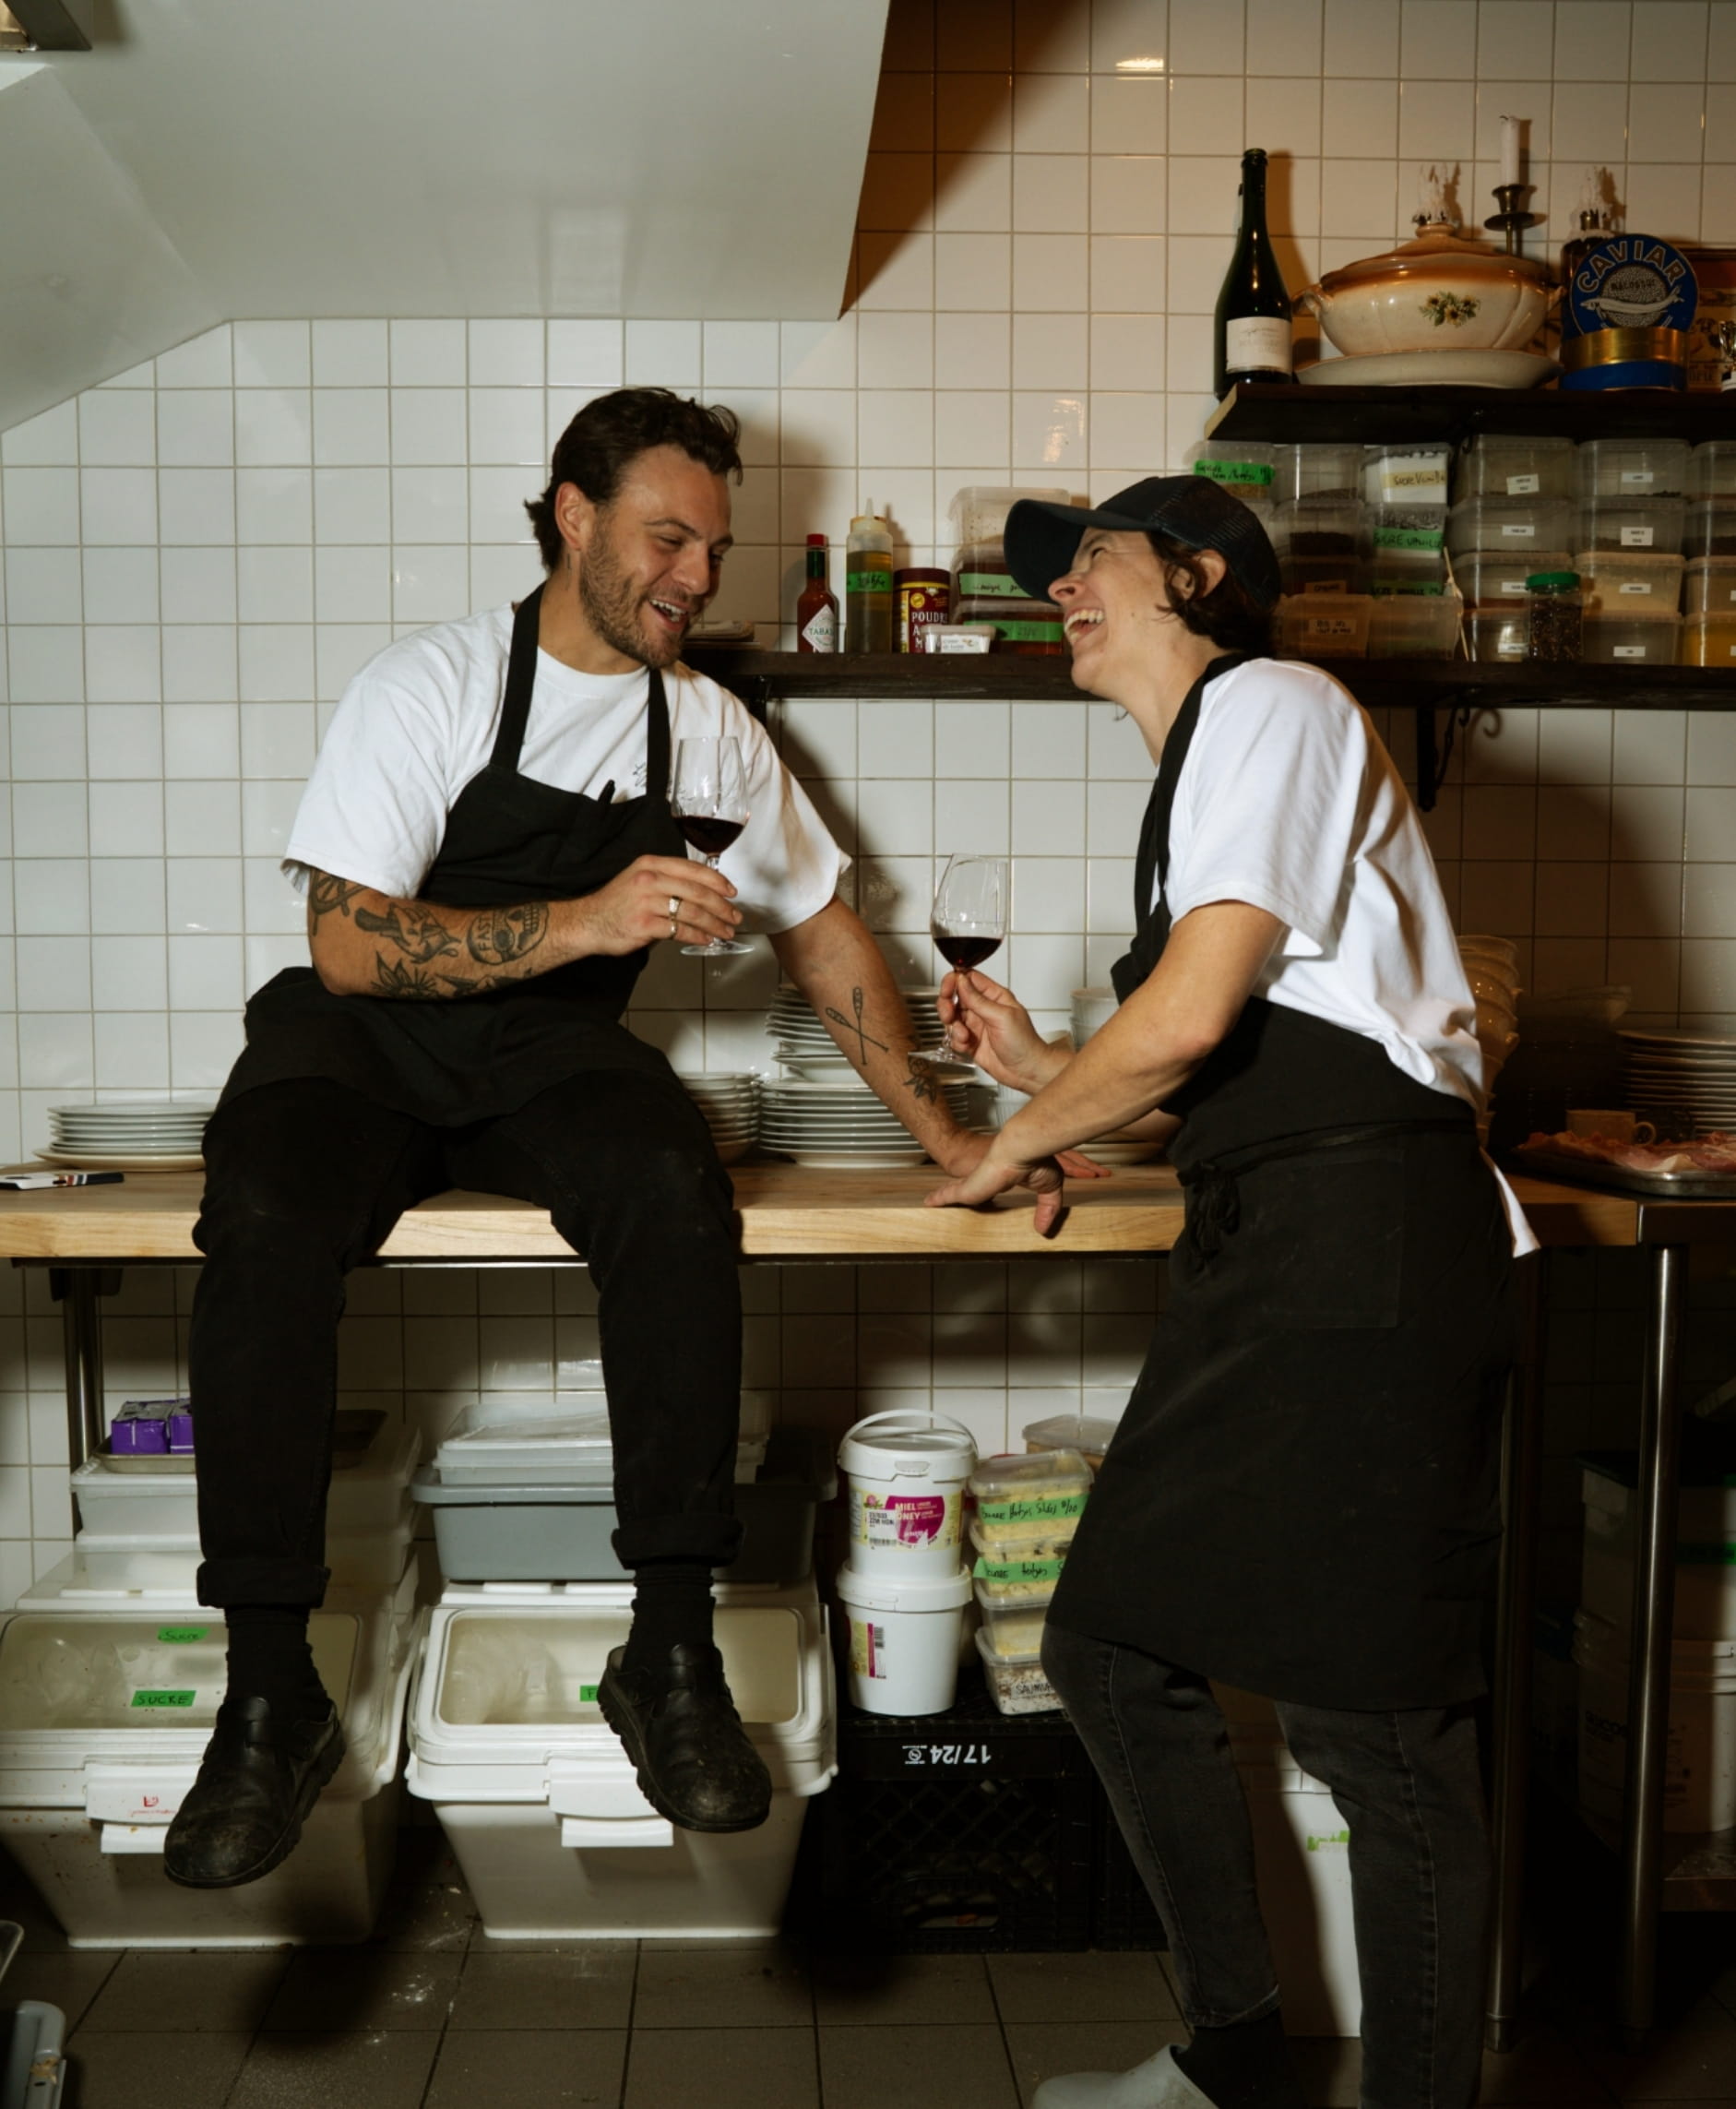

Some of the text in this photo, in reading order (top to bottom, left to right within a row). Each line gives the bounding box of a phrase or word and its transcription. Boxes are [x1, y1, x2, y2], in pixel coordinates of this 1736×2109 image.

[1577, 240, 1686, 293] CAVIAR
[478, 915, 493, 952] FAST
[895, 1503, 916, 1512] MIEL
[138, 1695, 189, 1706] SUCRE
[929, 1745, 992, 1765] 17/24
